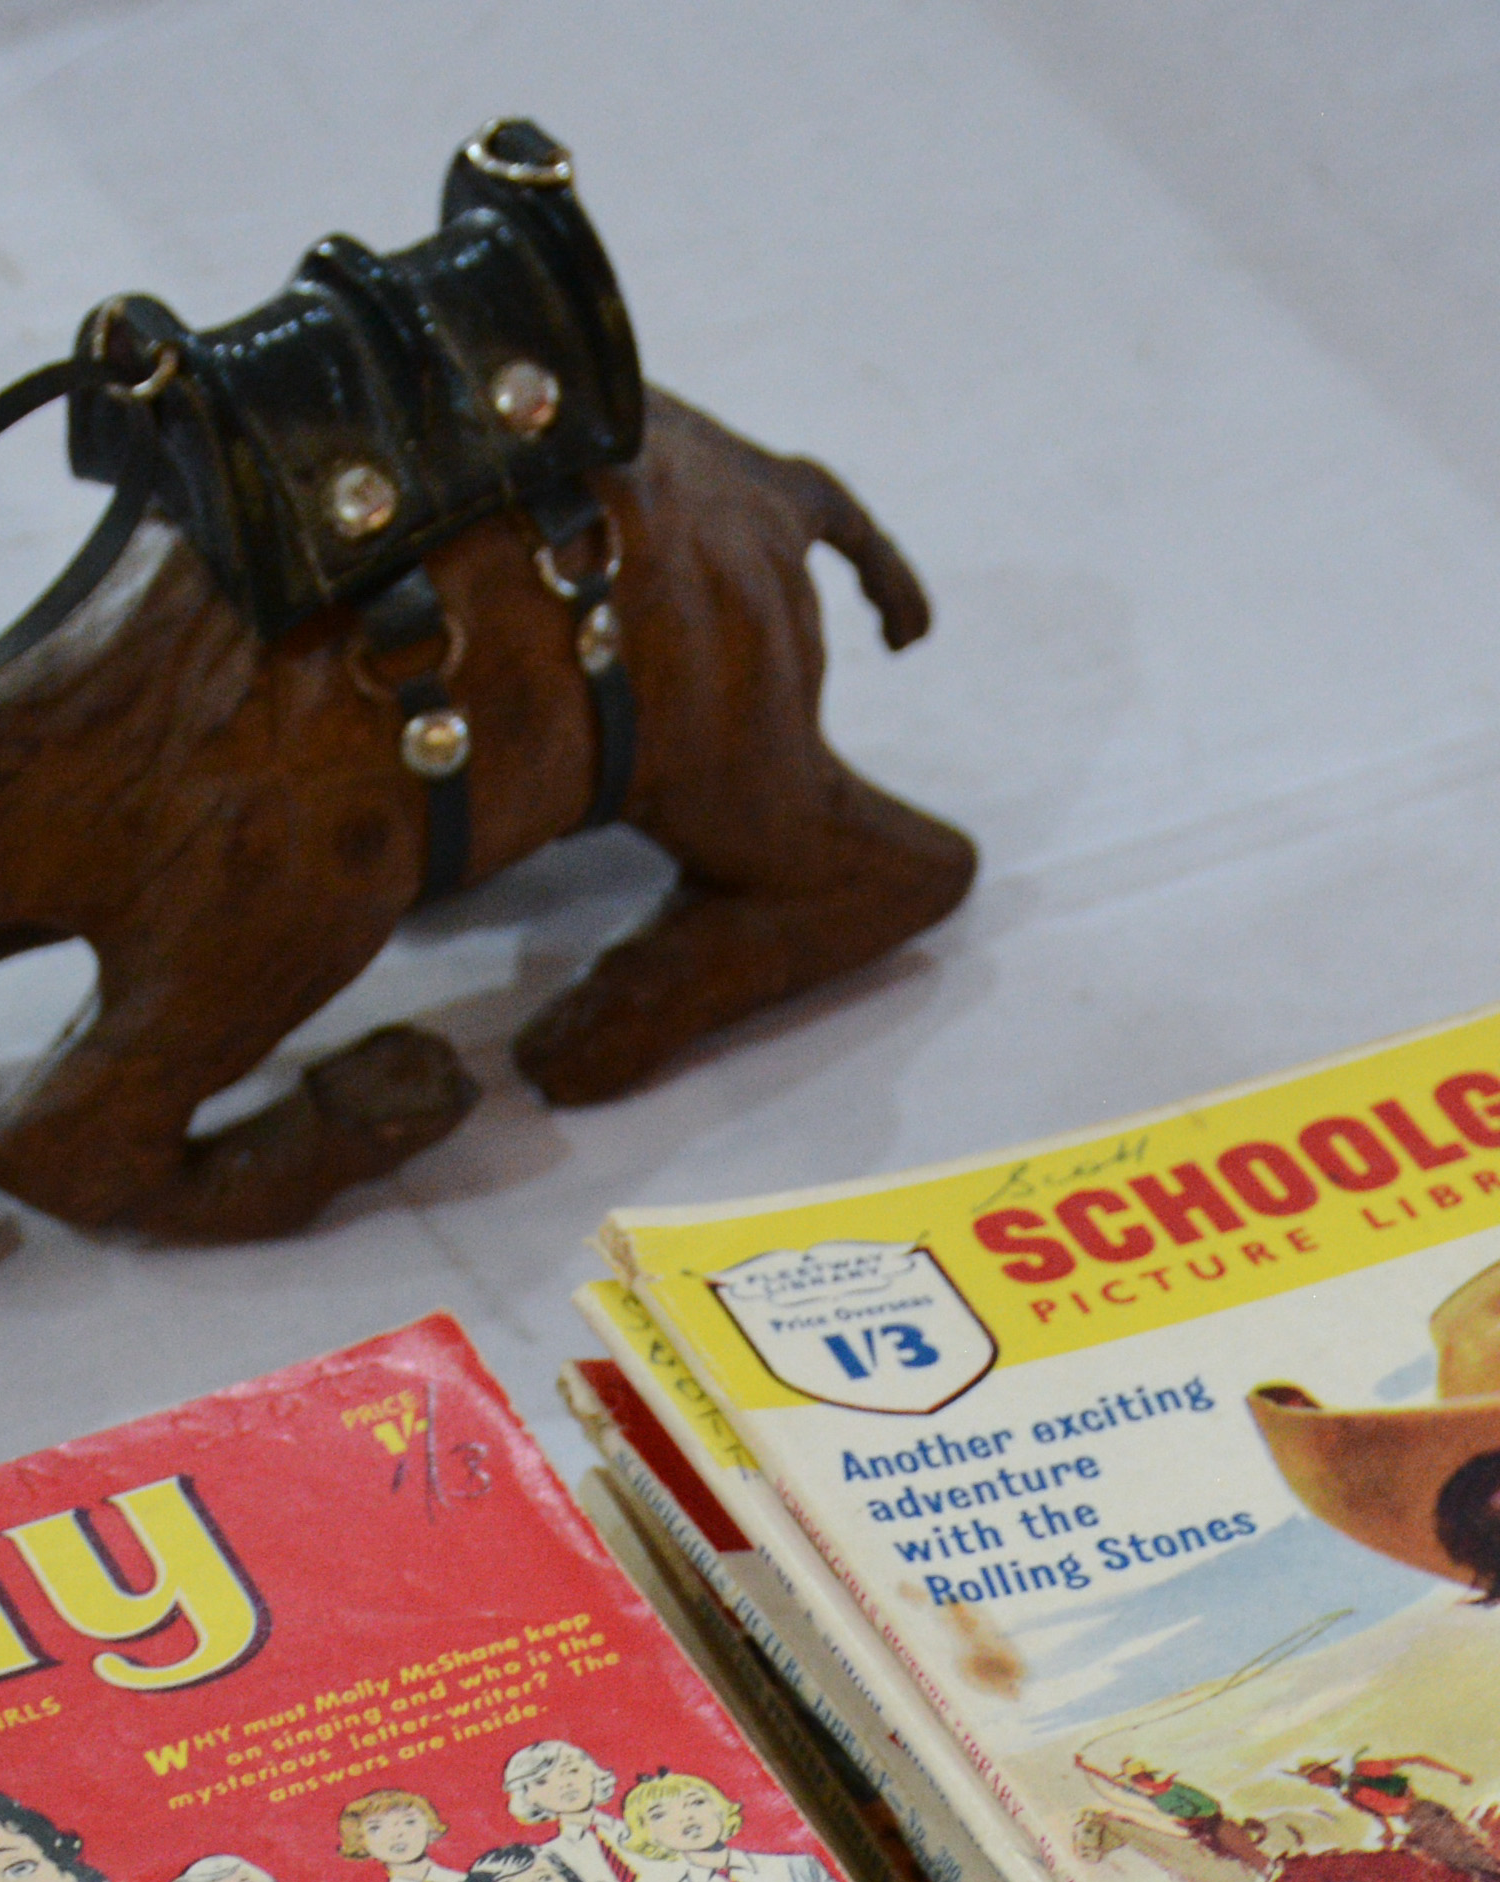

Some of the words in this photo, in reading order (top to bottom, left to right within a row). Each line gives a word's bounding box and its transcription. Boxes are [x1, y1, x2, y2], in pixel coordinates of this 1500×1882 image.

[768, 1311, 832, 1334] Price
[835, 1292, 935, 1324] Overseas
[1029, 1224, 1321, 1328] PICTURE
[821, 1323, 941, 1382] 1/3
[840, 1427, 1015, 1484] Another
[1031, 1376, 1217, 1449] exciting
[865, 1453, 1103, 1524] adventure
[895, 1522, 1004, 1565] with
[1018, 1499, 1102, 1541] the
[924, 1541, 1092, 1608] Rolling
[1098, 1509, 1257, 1576] Stones
[144, 1725, 232, 1775] WHY
[243, 1703, 306, 1736] must
[314, 1677, 390, 1711] Molly
[400, 1634, 520, 1685] McShane
[524, 1612, 591, 1642] keep
[168, 1747, 331, 1808] mysterious
[349, 1671, 549, 1748] letter-writer?
[565, 1651, 620, 1677] The
[225, 1744, 262, 1766] on
[272, 1706, 382, 1752] singing
[390, 1681, 446, 1711] and
[458, 1657, 521, 1689] who
[527, 1648, 552, 1666] is
[557, 1631, 604, 1654] the
[268, 1753, 390, 1802] answers
[398, 1734, 445, 1760] are
[452, 1703, 548, 1742] inside.
